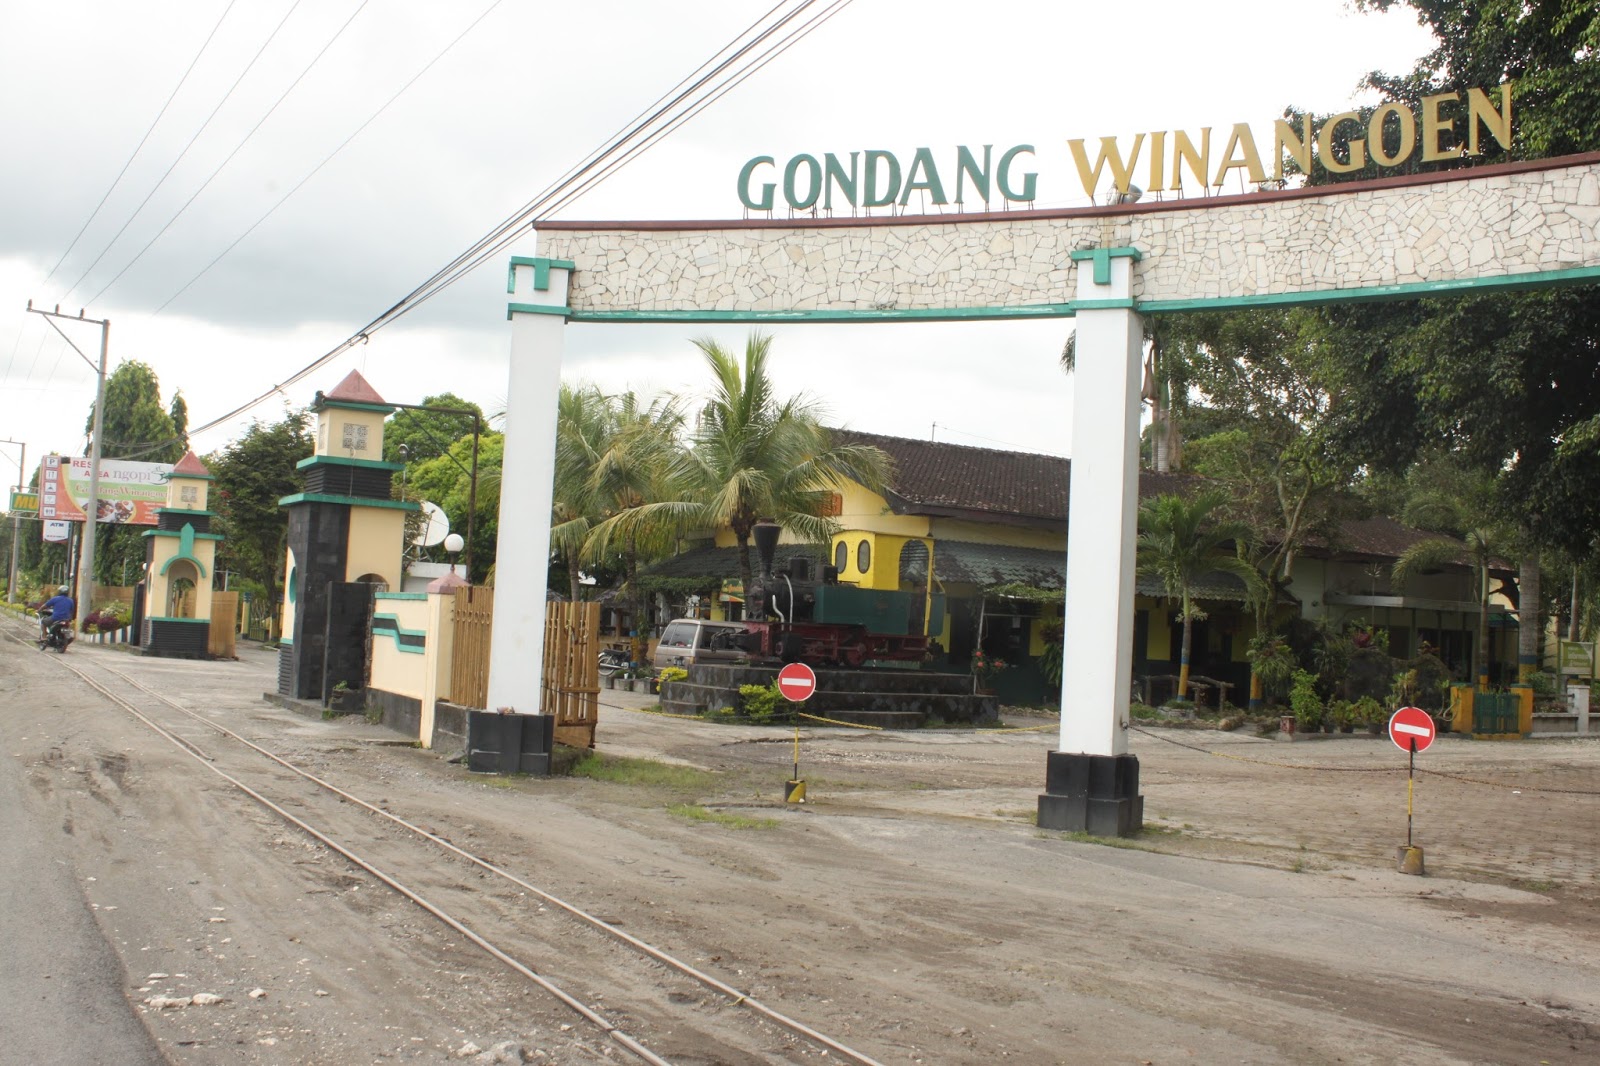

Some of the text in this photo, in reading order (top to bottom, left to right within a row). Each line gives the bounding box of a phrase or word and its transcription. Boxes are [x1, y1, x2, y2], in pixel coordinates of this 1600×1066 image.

[737, 83, 1512, 210] GONDANG WINANGOEN
[73, 460, 92, 468] RES
[84, 470, 109, 478] AEA
[113, 469, 151, 482] ngopi
[14, 495, 39, 509] MU
